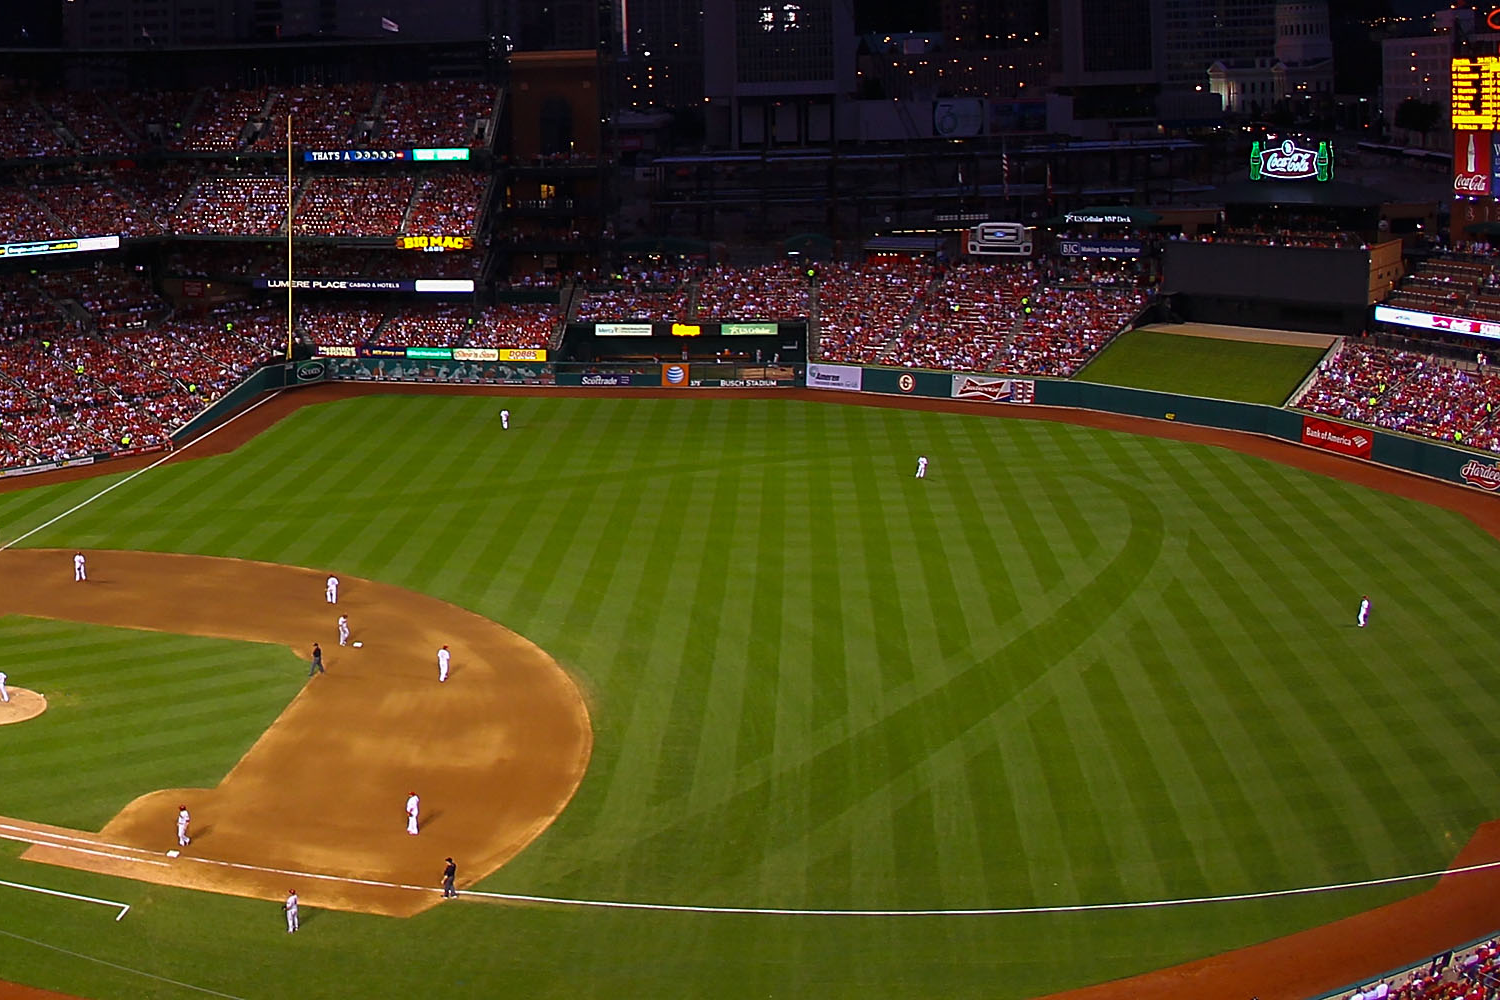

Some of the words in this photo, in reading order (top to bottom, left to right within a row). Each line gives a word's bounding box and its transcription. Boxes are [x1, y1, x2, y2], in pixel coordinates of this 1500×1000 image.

[312, 151, 340, 160] THAT'S
[344, 151, 350, 160] A
[1454, 173, 1487, 191] Coca-Cola
[404, 236, 428, 249] BIG
[430, 236, 464, 249] MAC
[1063, 244, 1078, 253] BJC
[267, 280, 310, 288] LUMERE
[312, 281, 348, 289] PLACE
[300, 367, 321, 377] Scotts
[581, 375, 618, 385] Scottrade
[902, 376, 910, 387] 6
[1306, 427, 1321, 439] Bank
[1321, 431, 1328, 440] of
[1327, 432, 1352, 446] America
